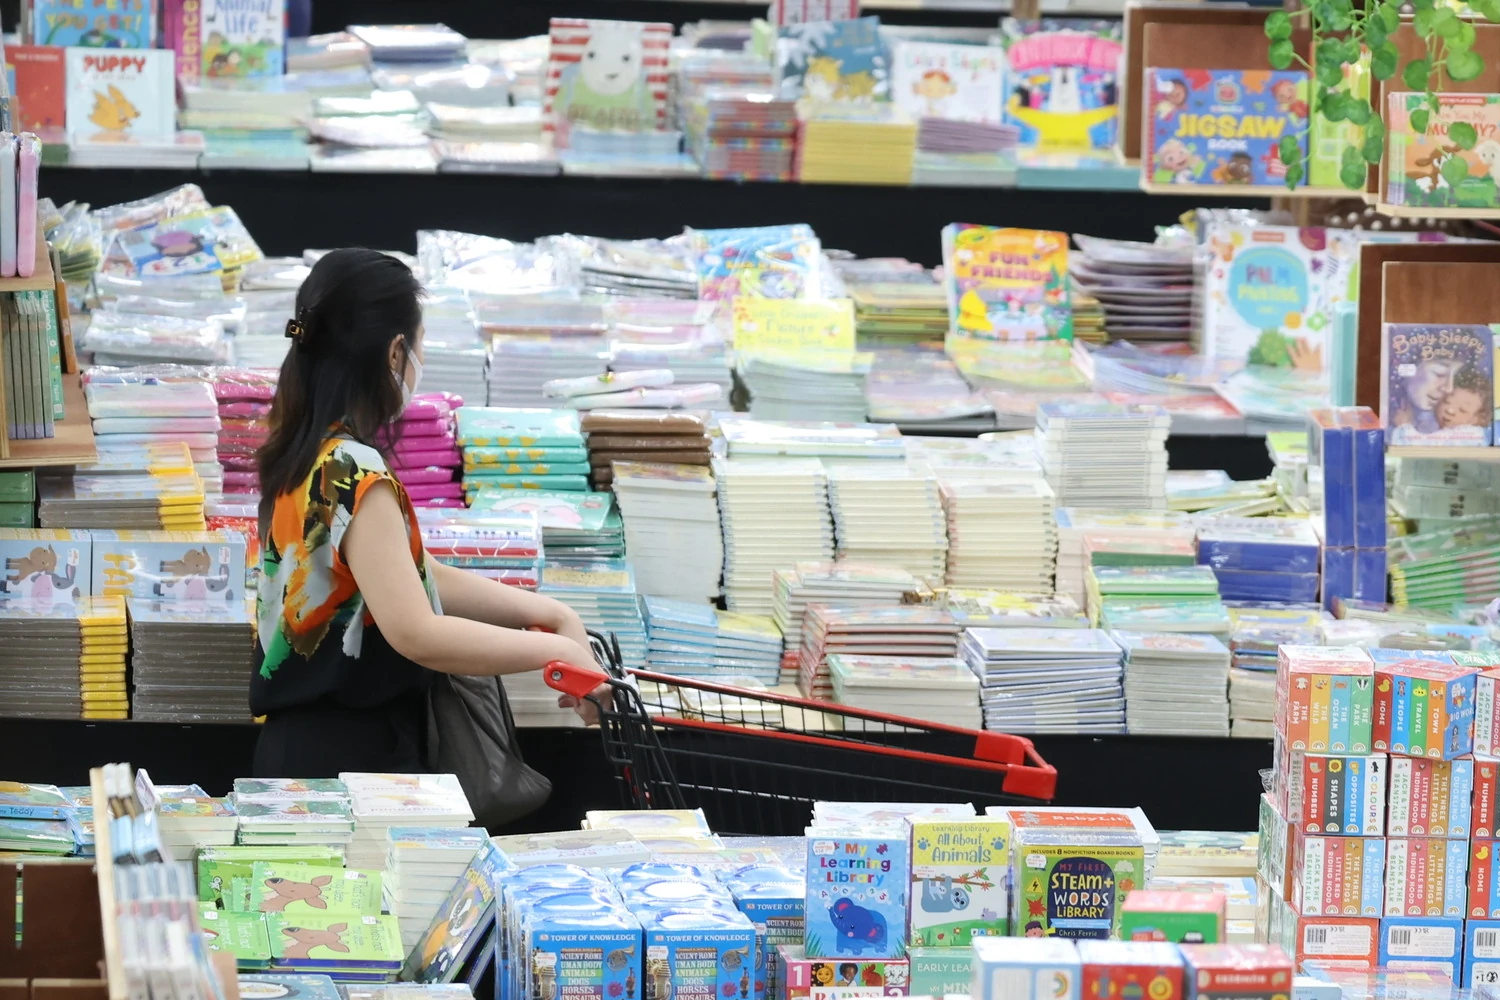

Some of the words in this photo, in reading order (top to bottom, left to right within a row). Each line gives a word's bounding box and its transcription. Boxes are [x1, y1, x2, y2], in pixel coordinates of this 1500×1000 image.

[83, 56, 146, 73] PUPPY
[1176, 114, 1286, 137] JIGSAW
[1208, 139, 1248, 150] BOOK
[990, 251, 1028, 265] FUN
[970, 266, 1053, 282] FRIENDS
[1393, 334, 1437, 353] Baby
[1440, 330, 1487, 353] Sleepy
[1422, 346, 1453, 360] Baby
[1397, 700, 1405, 732] PEOPLE
[1330, 780, 1338, 817] SHAPES
[1350, 776, 1358, 823] OPPOSITES
[1369, 776, 1378, 823] COLOURS
[937, 834, 950, 845] All
[953, 834, 982, 845] About
[846, 844, 867, 857] My
[933, 847, 991, 863] Animals
[821, 858, 891, 872] Learning
[827, 872, 884, 886] Library
[1052, 873, 1114, 889] STEAM+
[1054, 892, 1109, 906] WORDS
[793, 966, 802, 985] 1
[918, 963, 949, 972] EARLY
[563, 986, 594, 994] HORSES
